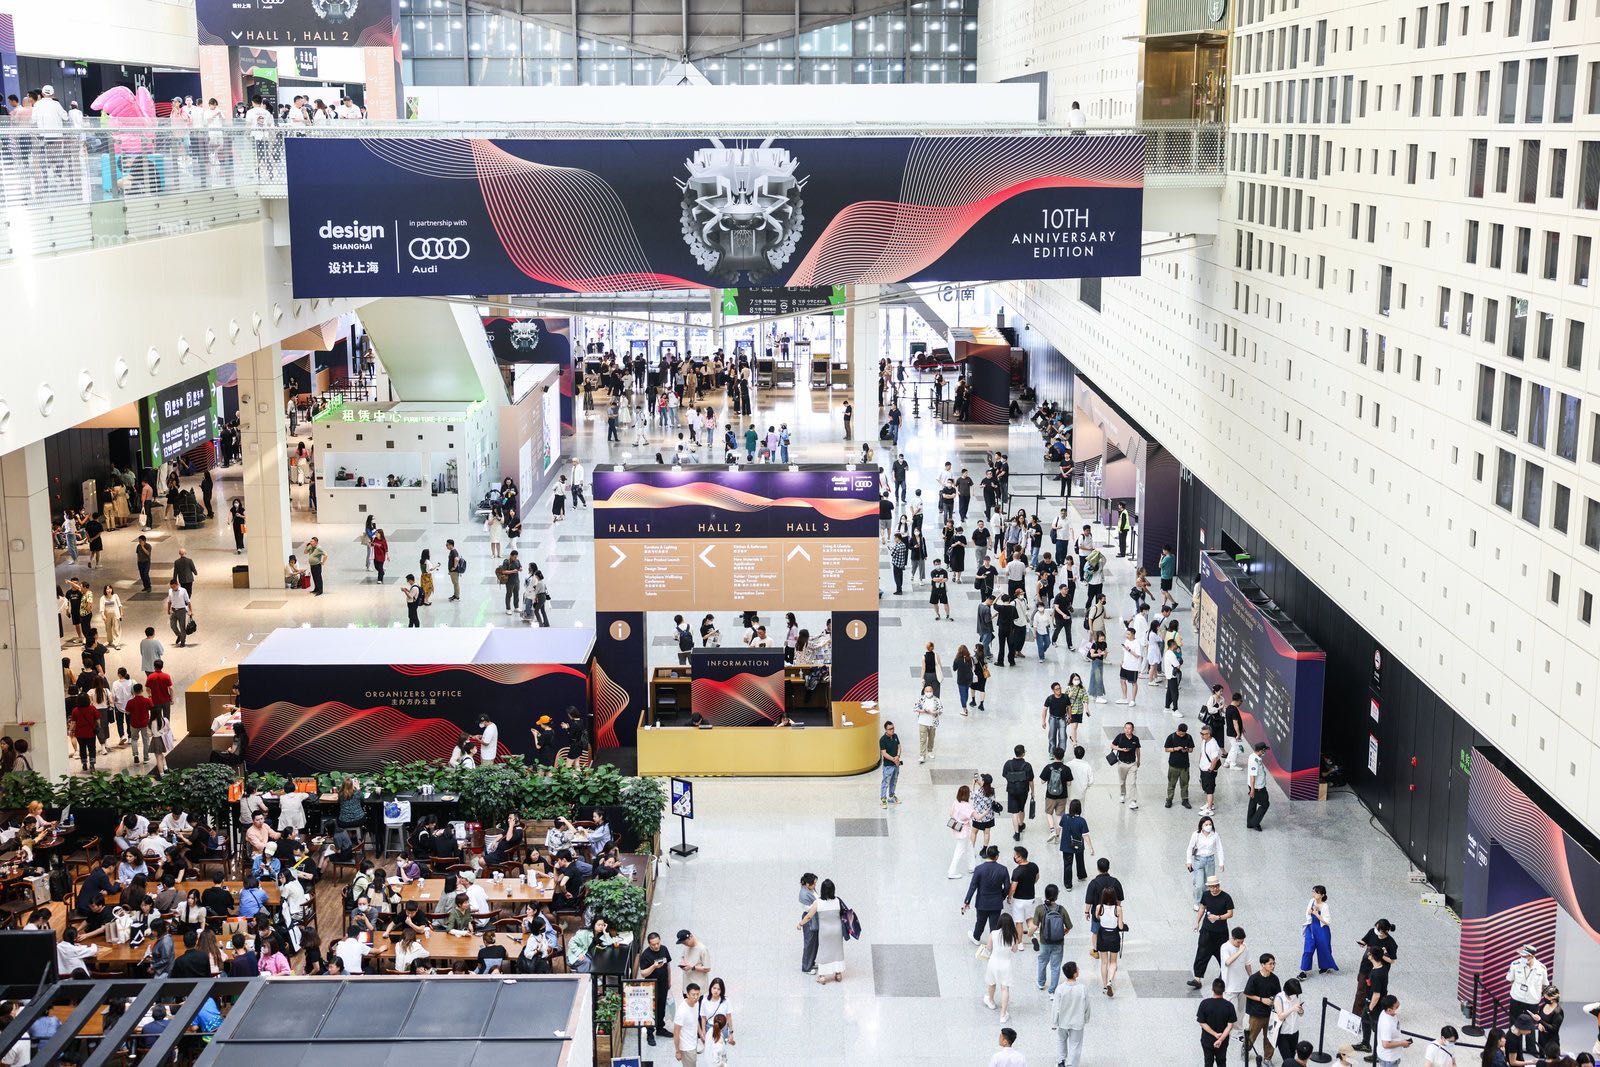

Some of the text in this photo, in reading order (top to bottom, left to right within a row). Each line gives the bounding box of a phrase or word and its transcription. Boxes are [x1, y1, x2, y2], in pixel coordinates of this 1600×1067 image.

[246, 31, 349, 42] HALL 1, HALL 2
[416, 219, 452, 228] partnership
[1041, 208, 1089, 229] 10TH
[318, 219, 385, 242] design
[1011, 231, 1117, 244] ANNIVERSARY
[1033, 246, 1095, 258] EDITION
[328, 261, 379, 274] 设计上海
[412, 265, 438, 274] Audi
[342, 410, 401, 423] 租赁中心
[609, 525, 639, 533] HALL
[698, 524, 741, 532] HALL 2
[787, 523, 829, 531] HALL 3
[365, 690, 426, 698] ORGANIZERS
